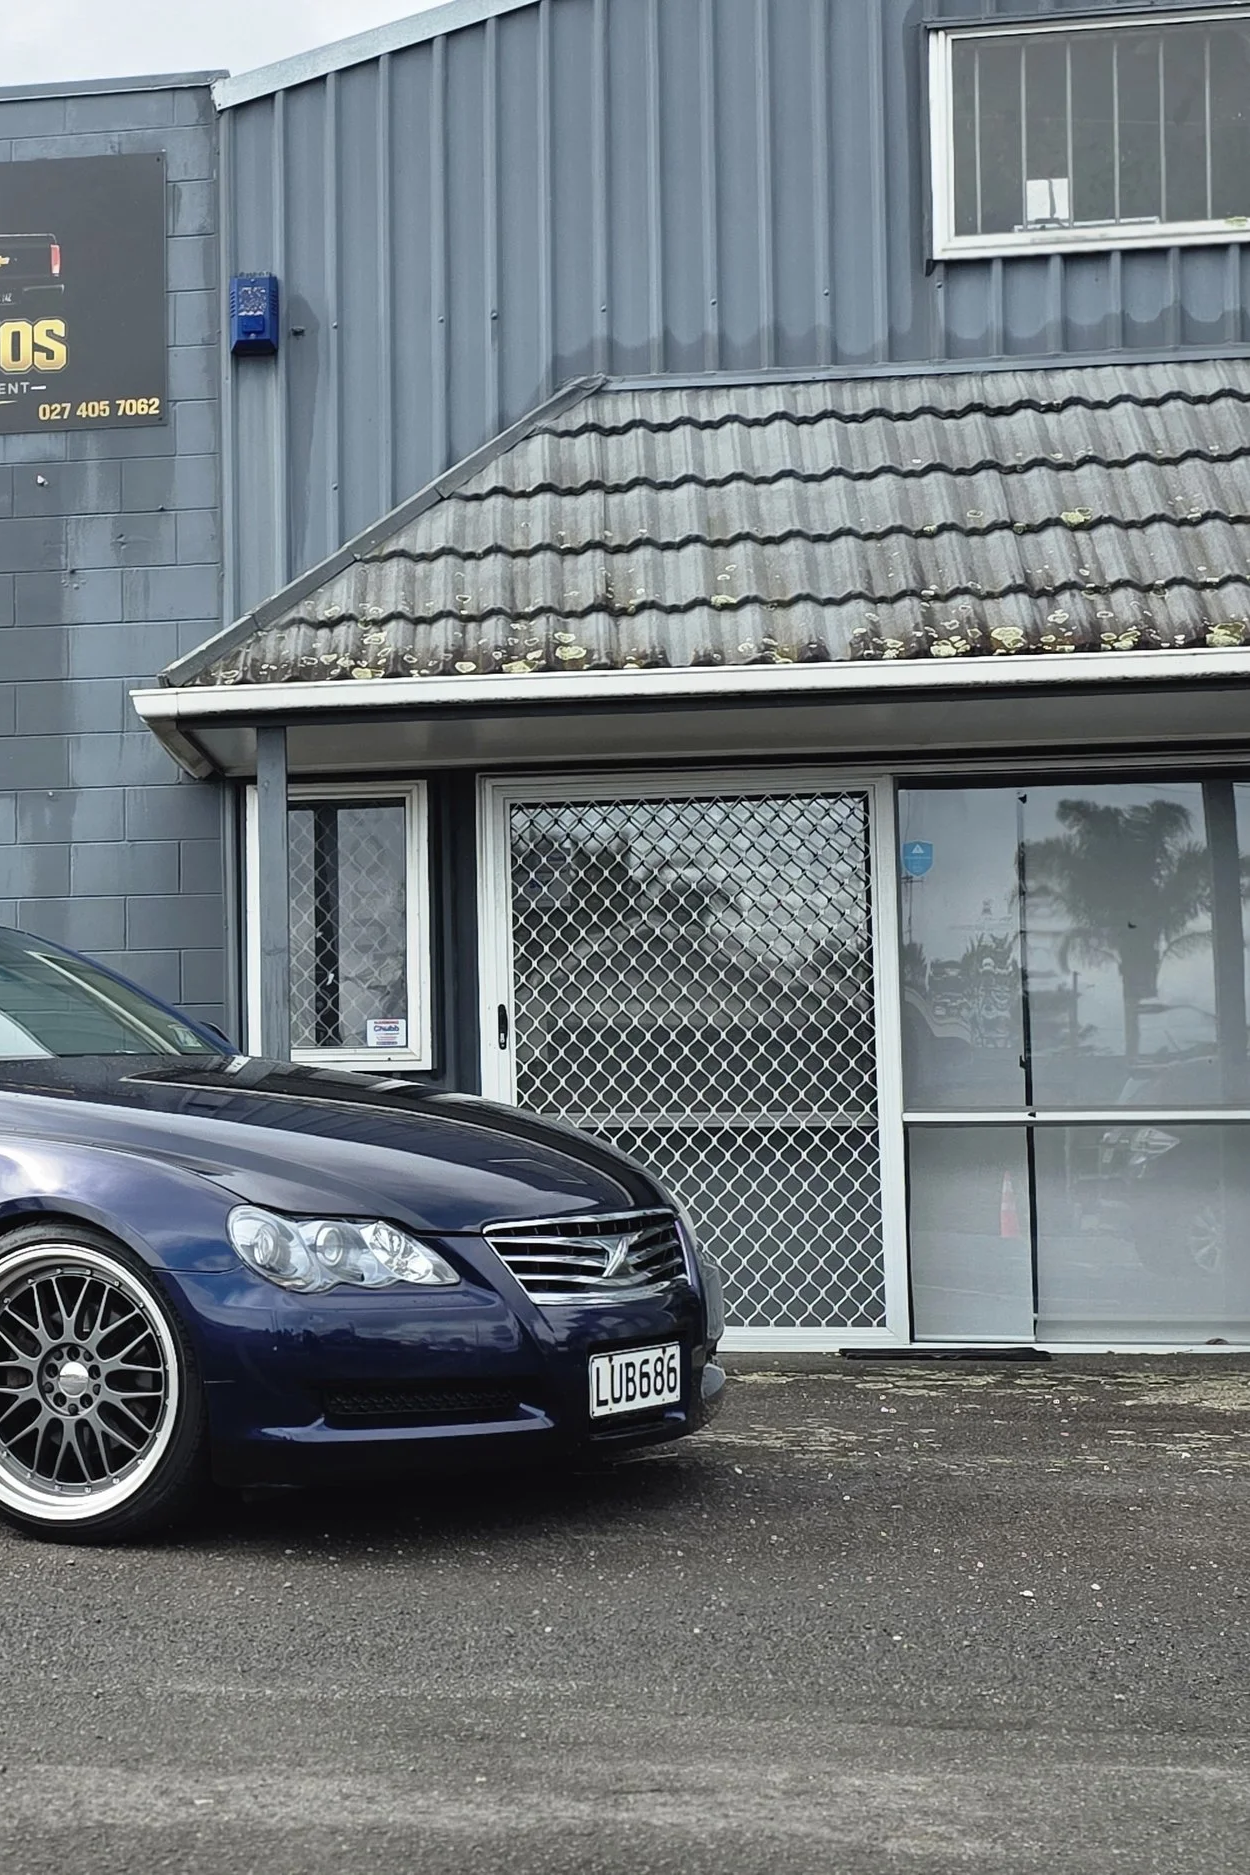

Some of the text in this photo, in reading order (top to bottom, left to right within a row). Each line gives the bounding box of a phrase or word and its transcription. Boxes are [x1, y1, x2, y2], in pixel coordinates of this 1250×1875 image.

[38, 397, 160, 421] 027 405 7062
[596, 1353, 678, 1407] LUB686
